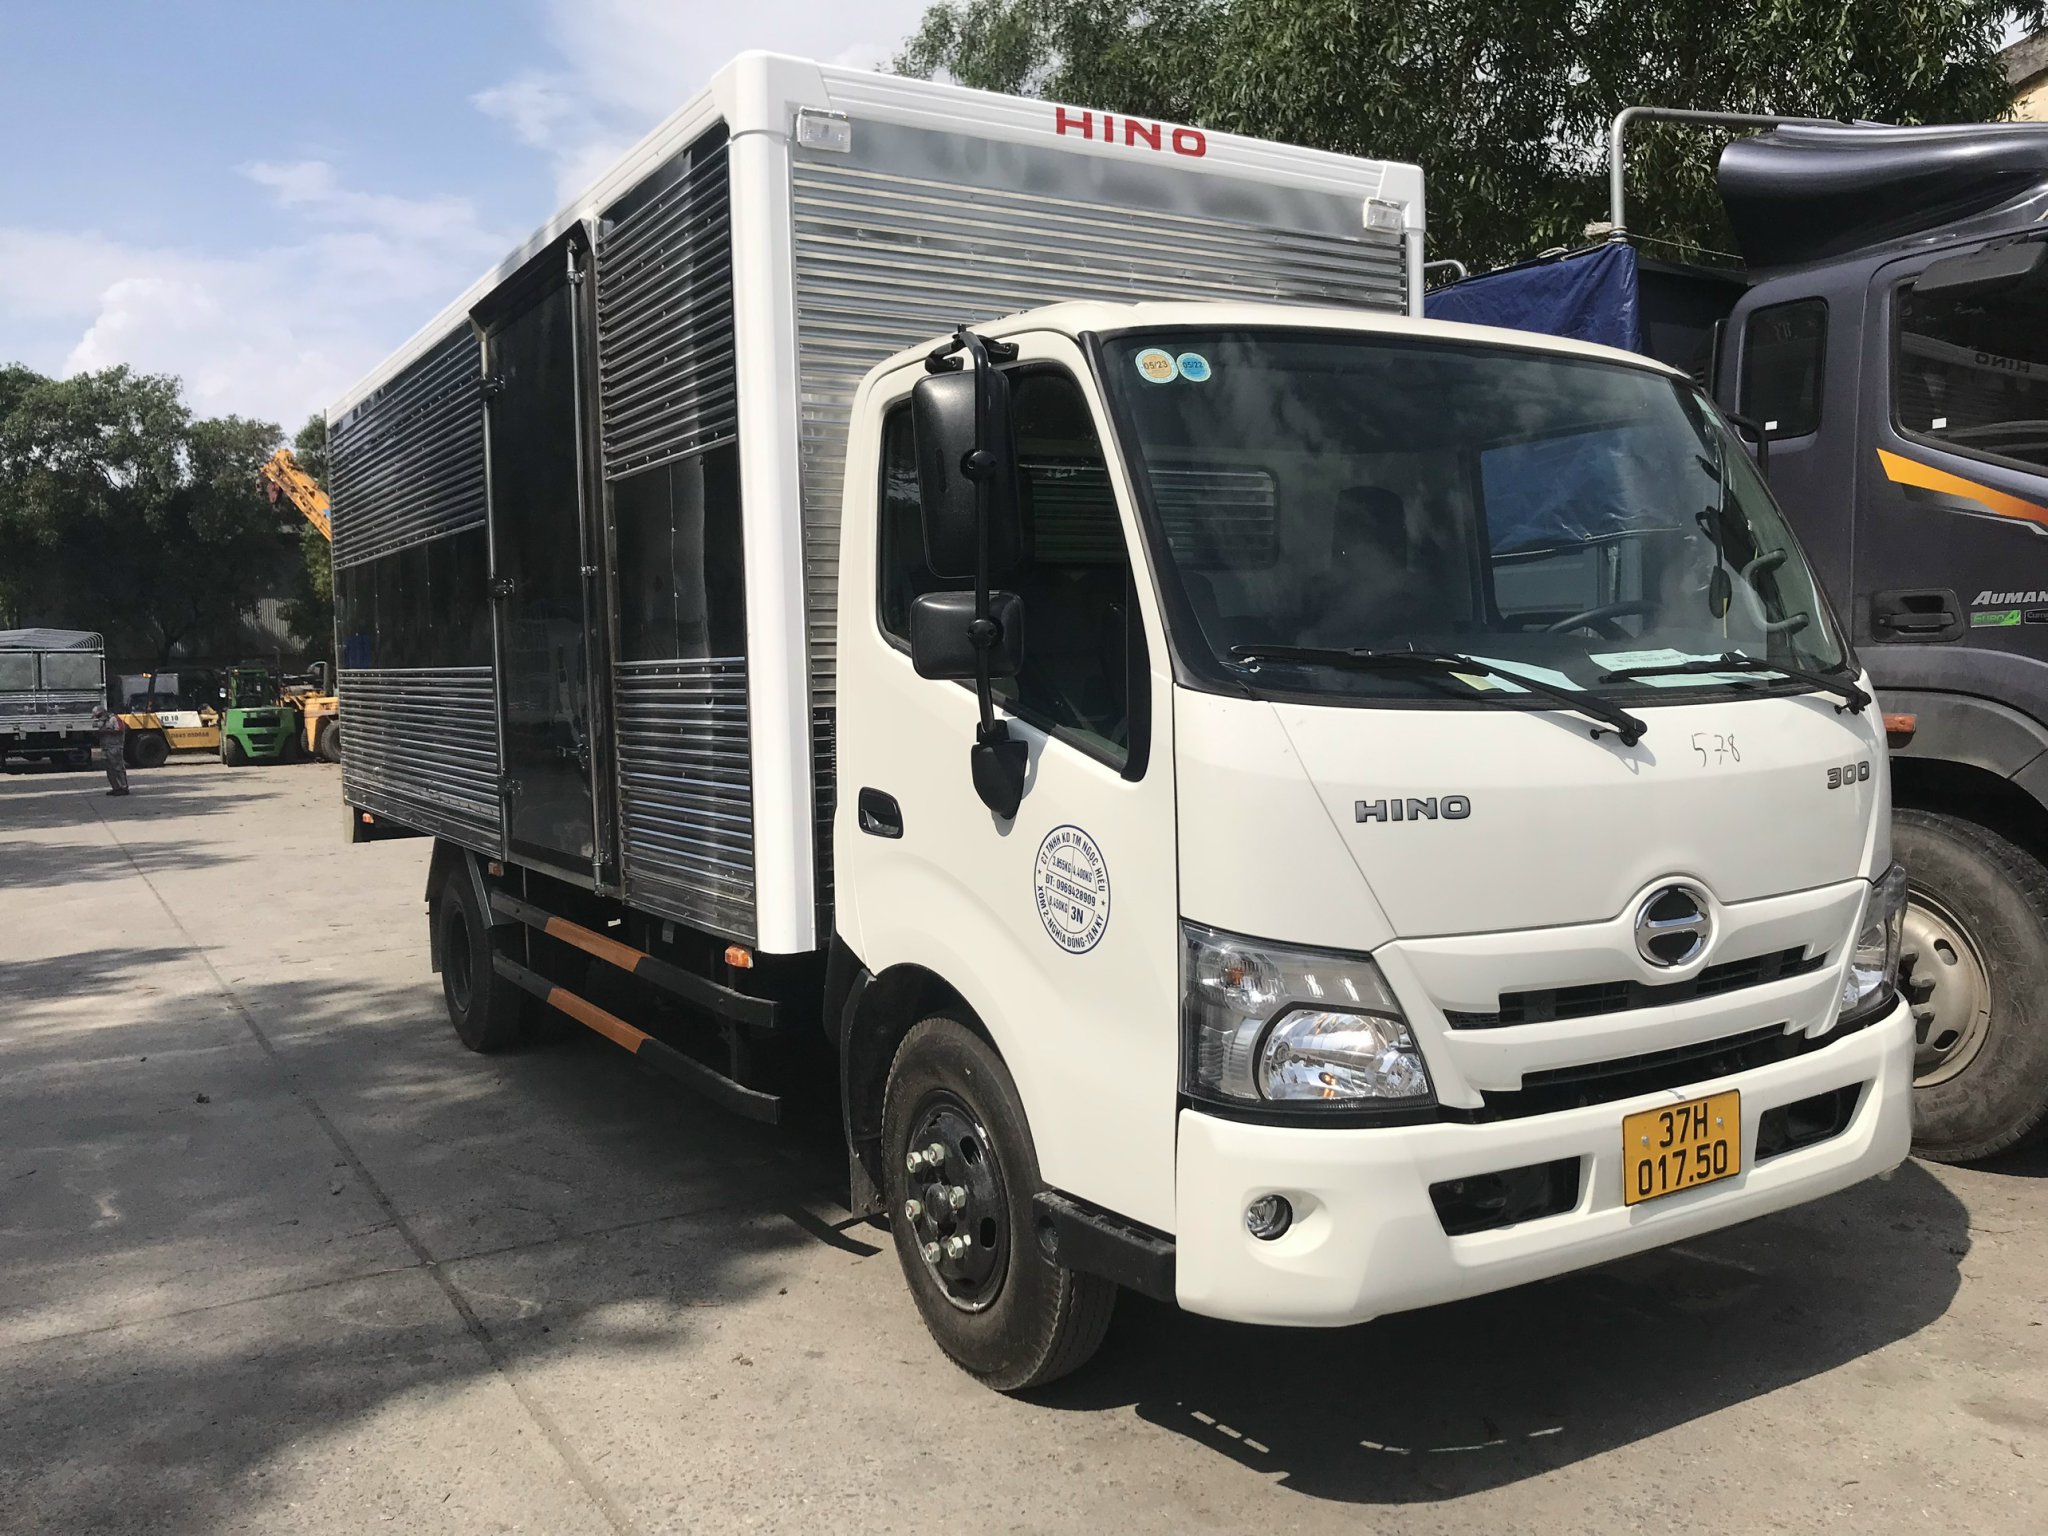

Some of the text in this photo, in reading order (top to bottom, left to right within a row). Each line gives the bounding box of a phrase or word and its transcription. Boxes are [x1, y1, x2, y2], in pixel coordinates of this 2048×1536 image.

[1056, 107, 1206, 157] HINO
[1143, 360, 1169, 370] 05/23
[1182, 361, 1203, 369] 05/22
[1691, 733, 1741, 767] 578
[1827, 761, 1870, 789] 300
[1355, 795, 1471, 823] HINO
[1040, 851, 1049, 865] CT
[1045, 834, 1062, 854] TNHH
[1061, 832, 1071, 844] KD
[1072, 833, 1082, 846] TM
[1056, 879, 1096, 907] 0969428909
[1070, 906, 1084, 925] 3N
[1659, 1102, 1708, 1148] 37H
[1638, 1139, 1728, 1196] 017.50
